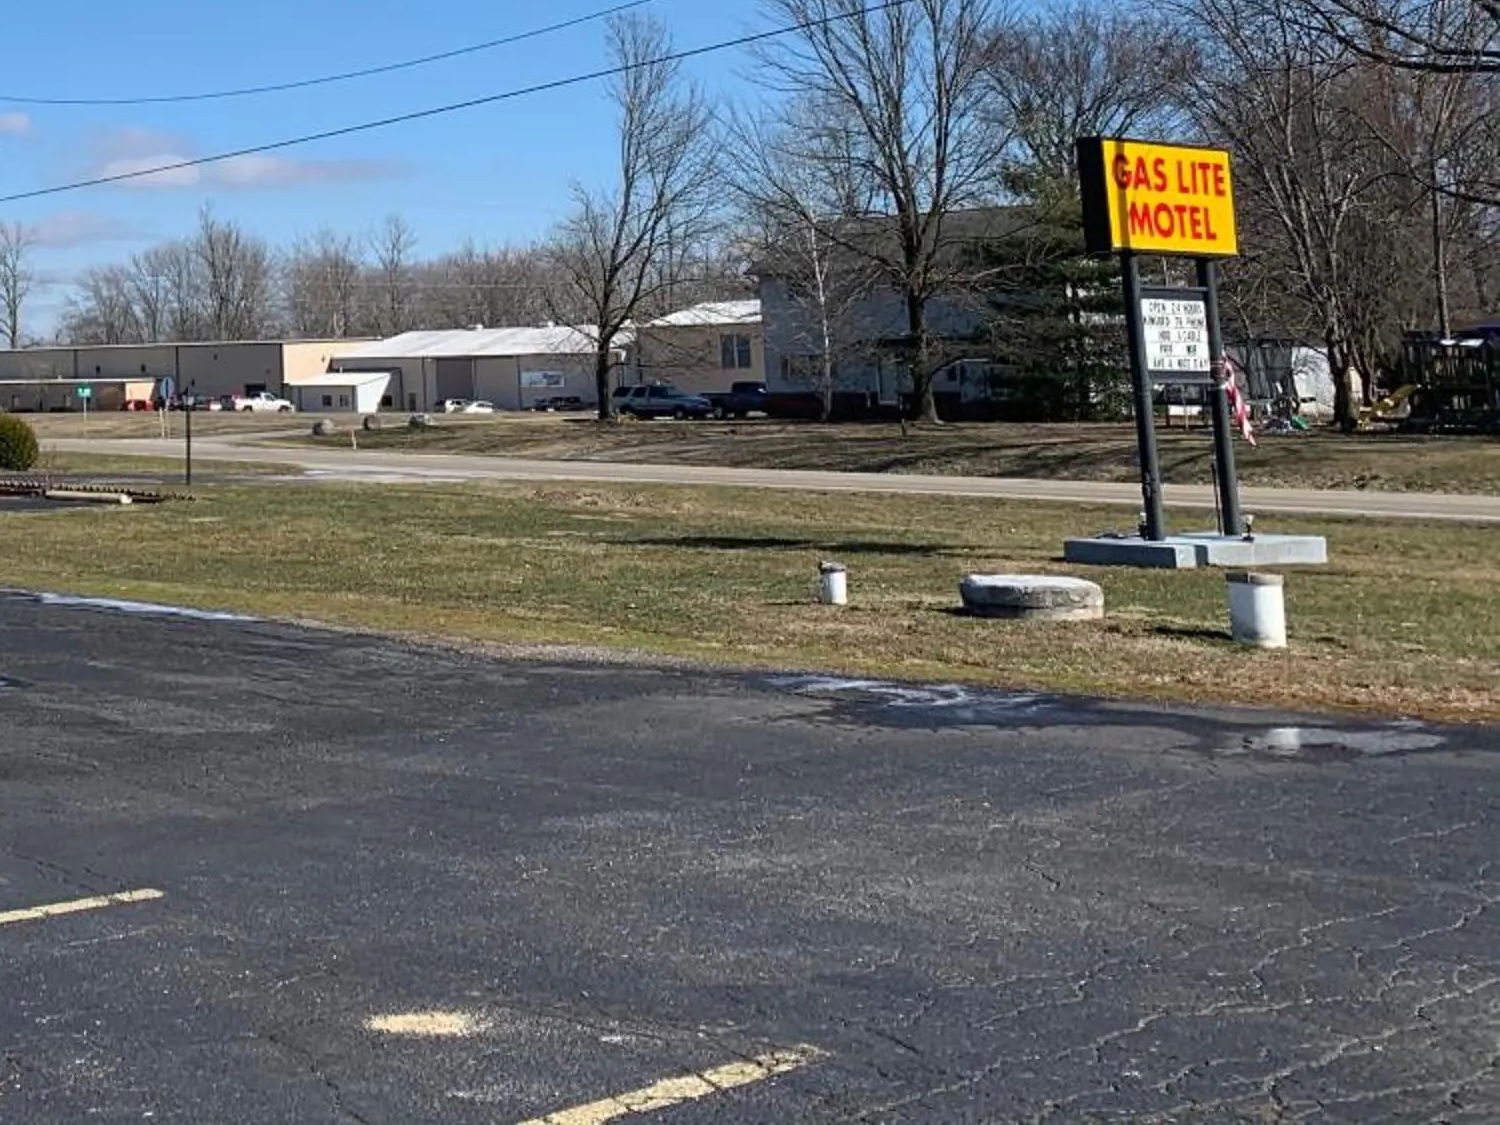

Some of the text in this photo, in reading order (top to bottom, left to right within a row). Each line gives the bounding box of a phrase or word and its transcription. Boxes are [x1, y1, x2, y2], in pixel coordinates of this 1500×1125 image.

[1112, 153, 1226, 197] GAS LITE
[1130, 201, 1217, 240] MOTEL
